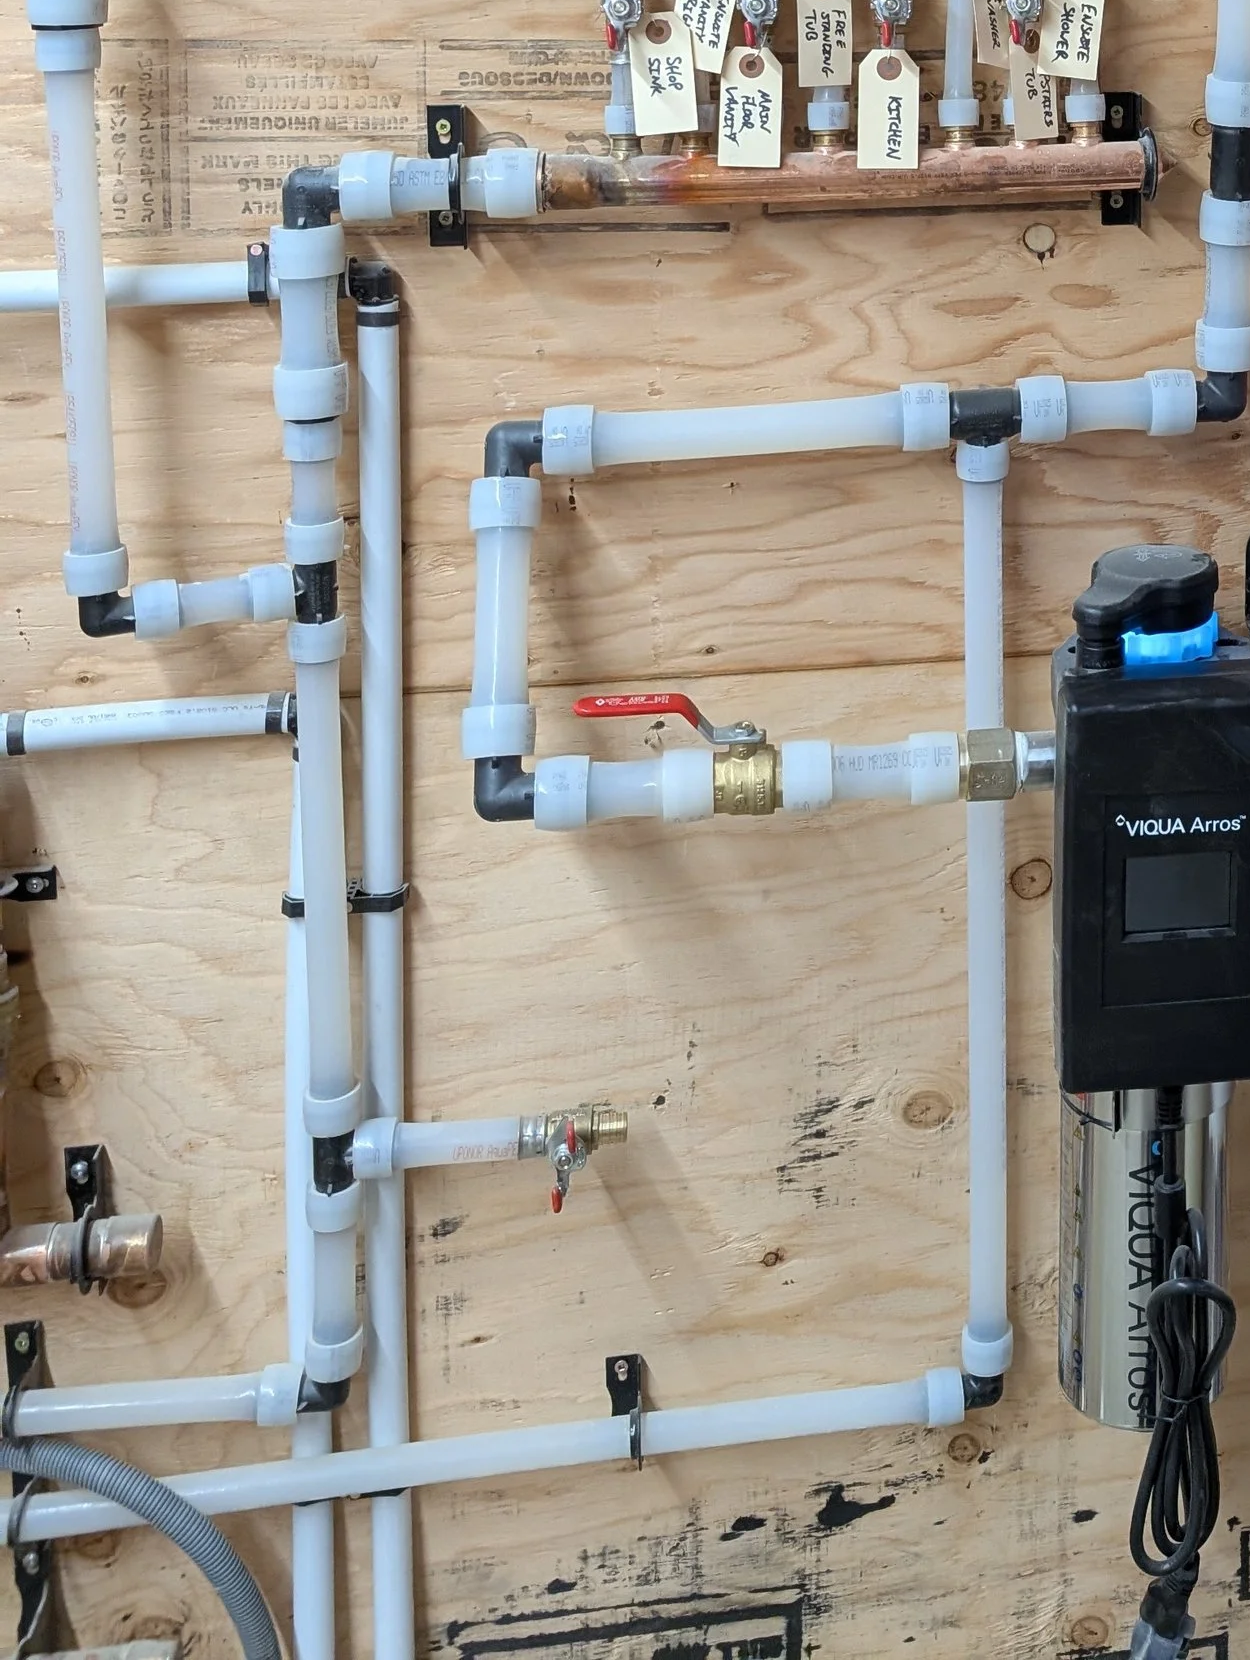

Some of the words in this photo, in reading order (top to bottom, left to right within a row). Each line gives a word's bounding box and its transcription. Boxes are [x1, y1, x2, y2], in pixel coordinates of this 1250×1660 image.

[803, 8, 818, 42] TUB
[819, 10, 834, 79] STANDING
[832, 9, 847, 49] FREE
[1050, 2, 1076, 64] SHOWER
[1076, 3, 1098, 65] ENSUITE
[648, 57, 666, 98] SINK
[665, 56, 684, 91] SHOP
[1024, 67, 1038, 101] TUB
[197, 116, 320, 131] UNIQUEMENT
[723, 86, 740, 148] VANITY
[738, 94, 757, 134] FLOOR
[757, 89, 773, 135] MAIN
[1038, 73, 1055, 128] PSTAIRS
[885, 95, 903, 161] KITCHEN
[1125, 817, 1186, 837] VIQUA
[1127, 1162, 1156, 1291] VIQUA
[1127, 1300, 1151, 1412] Arros
